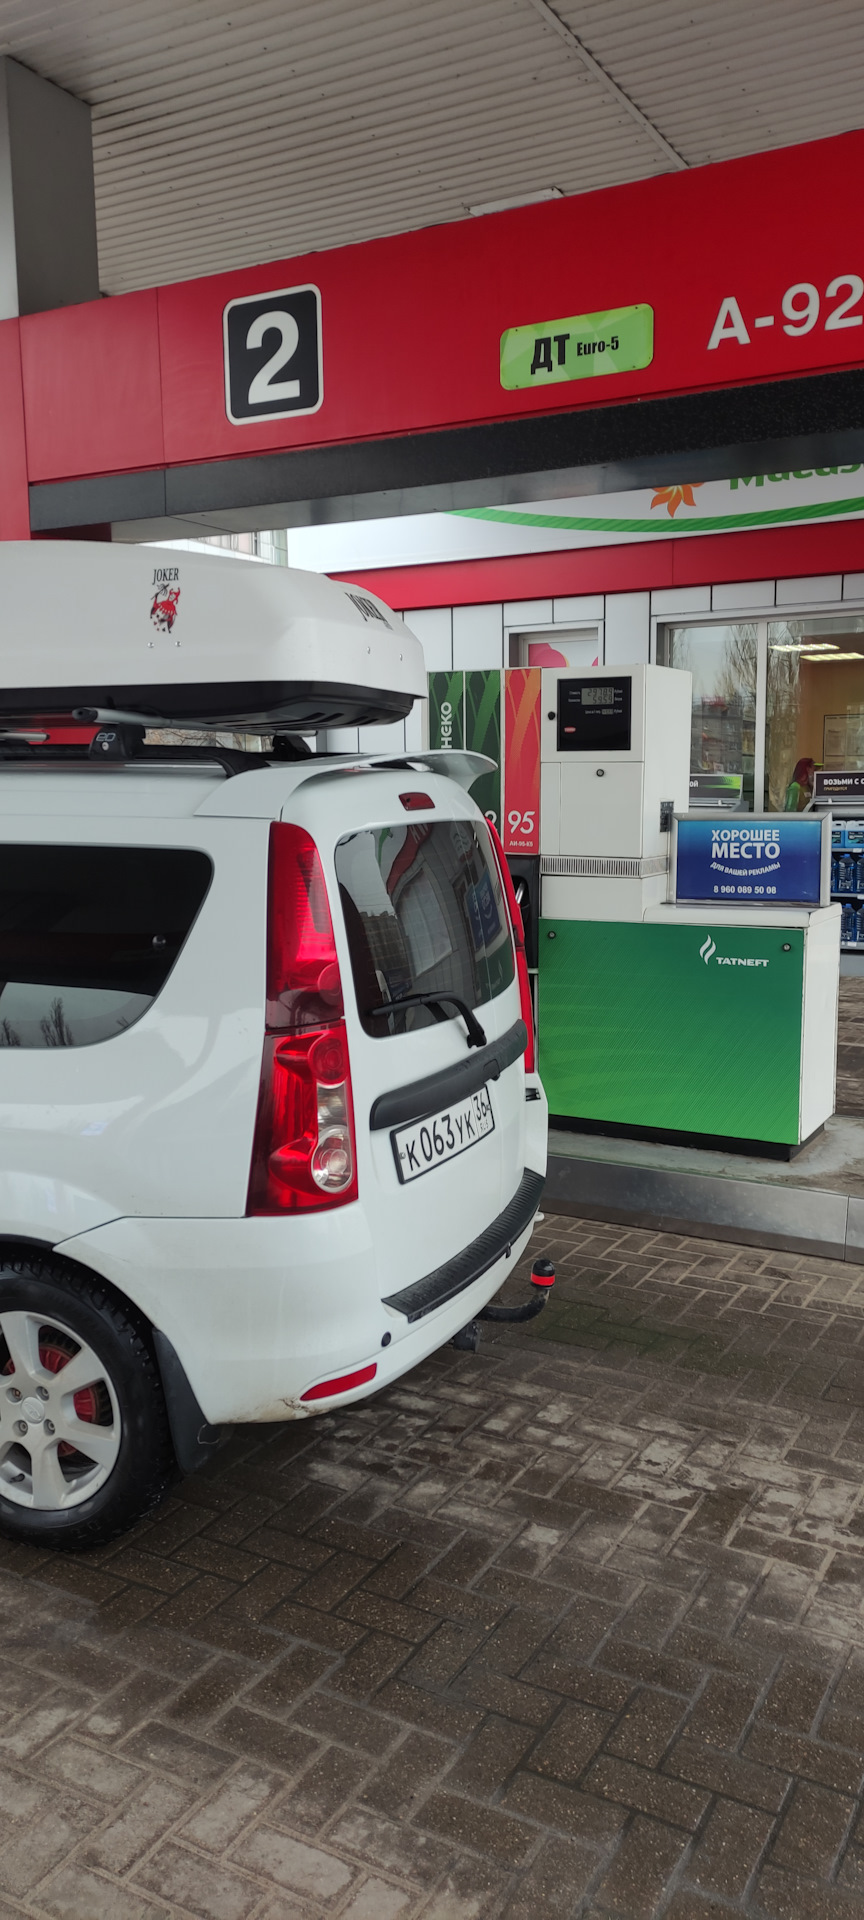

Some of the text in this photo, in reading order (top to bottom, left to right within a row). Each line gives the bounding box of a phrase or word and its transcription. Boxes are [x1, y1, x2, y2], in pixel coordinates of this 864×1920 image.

[246, 310, 300, 405] 2
[530, 333, 620, 376] ДТ Euro-5
[152, 567, 180, 586] JOKER
[440, 701, 453, 749] НЕКО
[507, 809, 536, 834] 95
[711, 829, 780, 842] ХОРОШЕЕ
[711, 842, 781, 859] МЕСТО
[709, 861, 781, 877] ДЛЯ ВАШЕЙ РЕКЛАМЫ
[713, 885, 777, 895] 8 960 089 50 08
[715, 956, 770, 968] TATNEFT
[473, 1091, 488, 1121] 36
